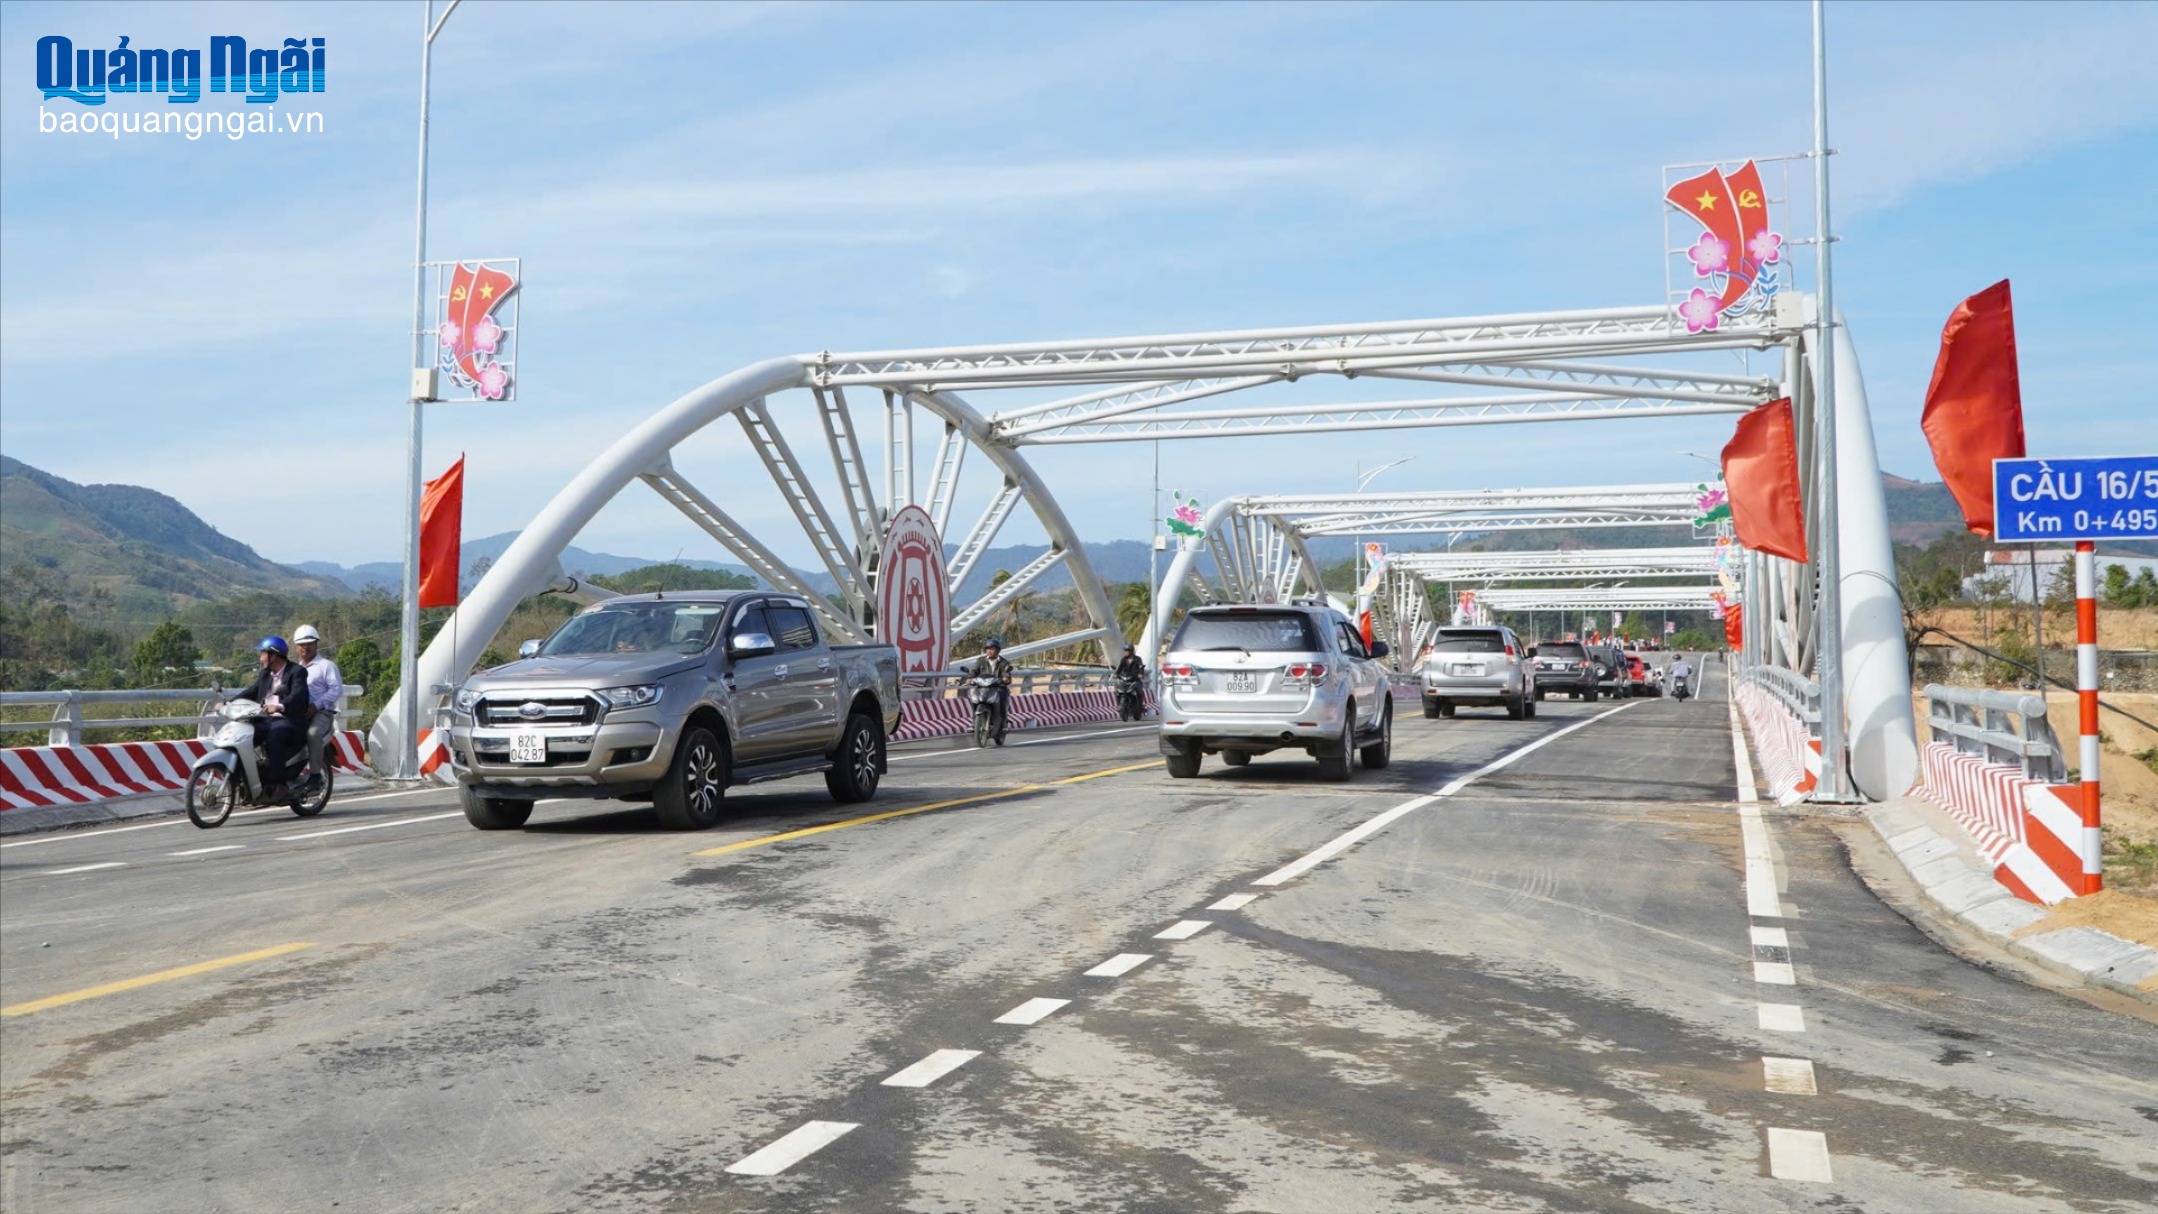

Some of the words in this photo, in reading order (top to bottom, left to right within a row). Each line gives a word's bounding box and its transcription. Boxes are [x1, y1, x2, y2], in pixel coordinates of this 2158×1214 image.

[2010, 460, 2083, 502] CẦU
[2096, 469, 2158, 500] 16/5
[2017, 511, 2062, 533] Km
[2073, 510, 2158, 532] 0+495
[517, 735, 537, 748] 82C
[510, 748, 544, 761] 042.87
